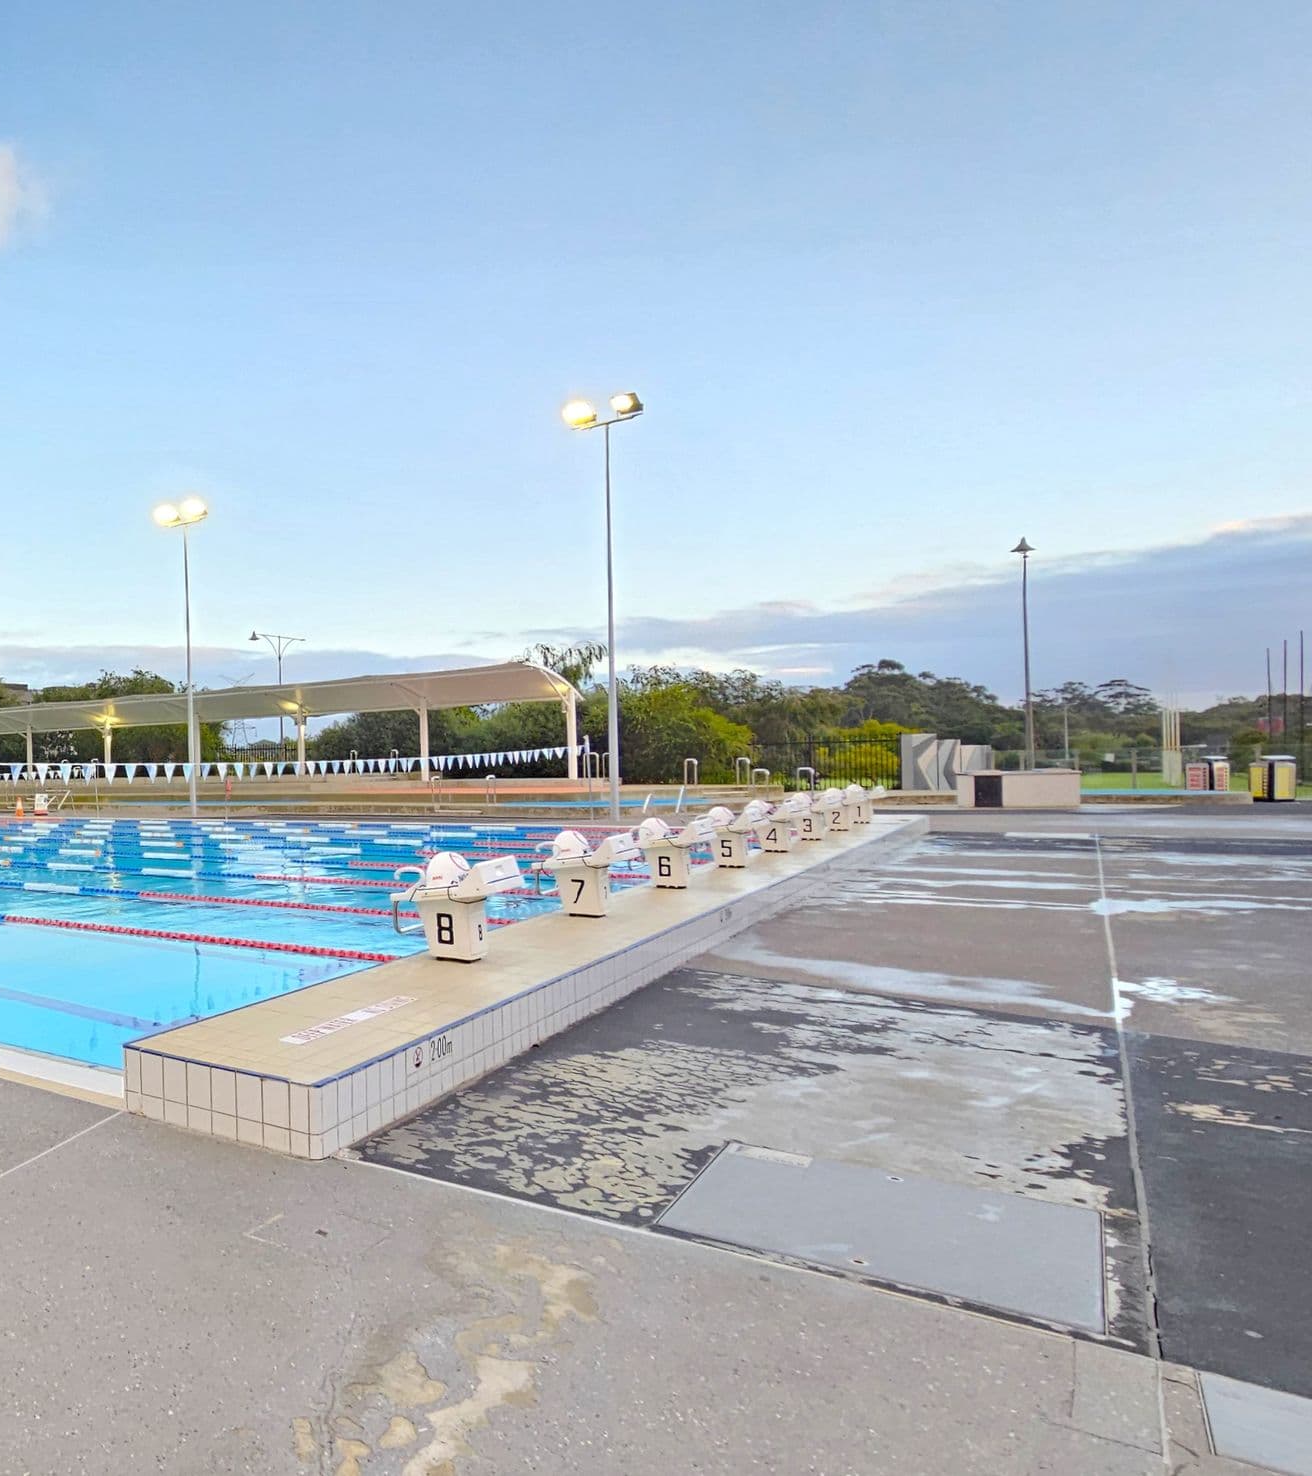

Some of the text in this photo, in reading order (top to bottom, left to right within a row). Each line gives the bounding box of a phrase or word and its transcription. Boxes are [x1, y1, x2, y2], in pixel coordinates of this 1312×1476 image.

[832, 811, 840, 825] 2
[856, 806, 862, 818] 1
[803, 818, 812, 832] 3
[766, 828, 777, 843] 4
[721, 840, 732, 857] 5
[658, 856, 671, 877] 6
[571, 879, 585, 904] 7
[436, 912, 454, 945] 8
